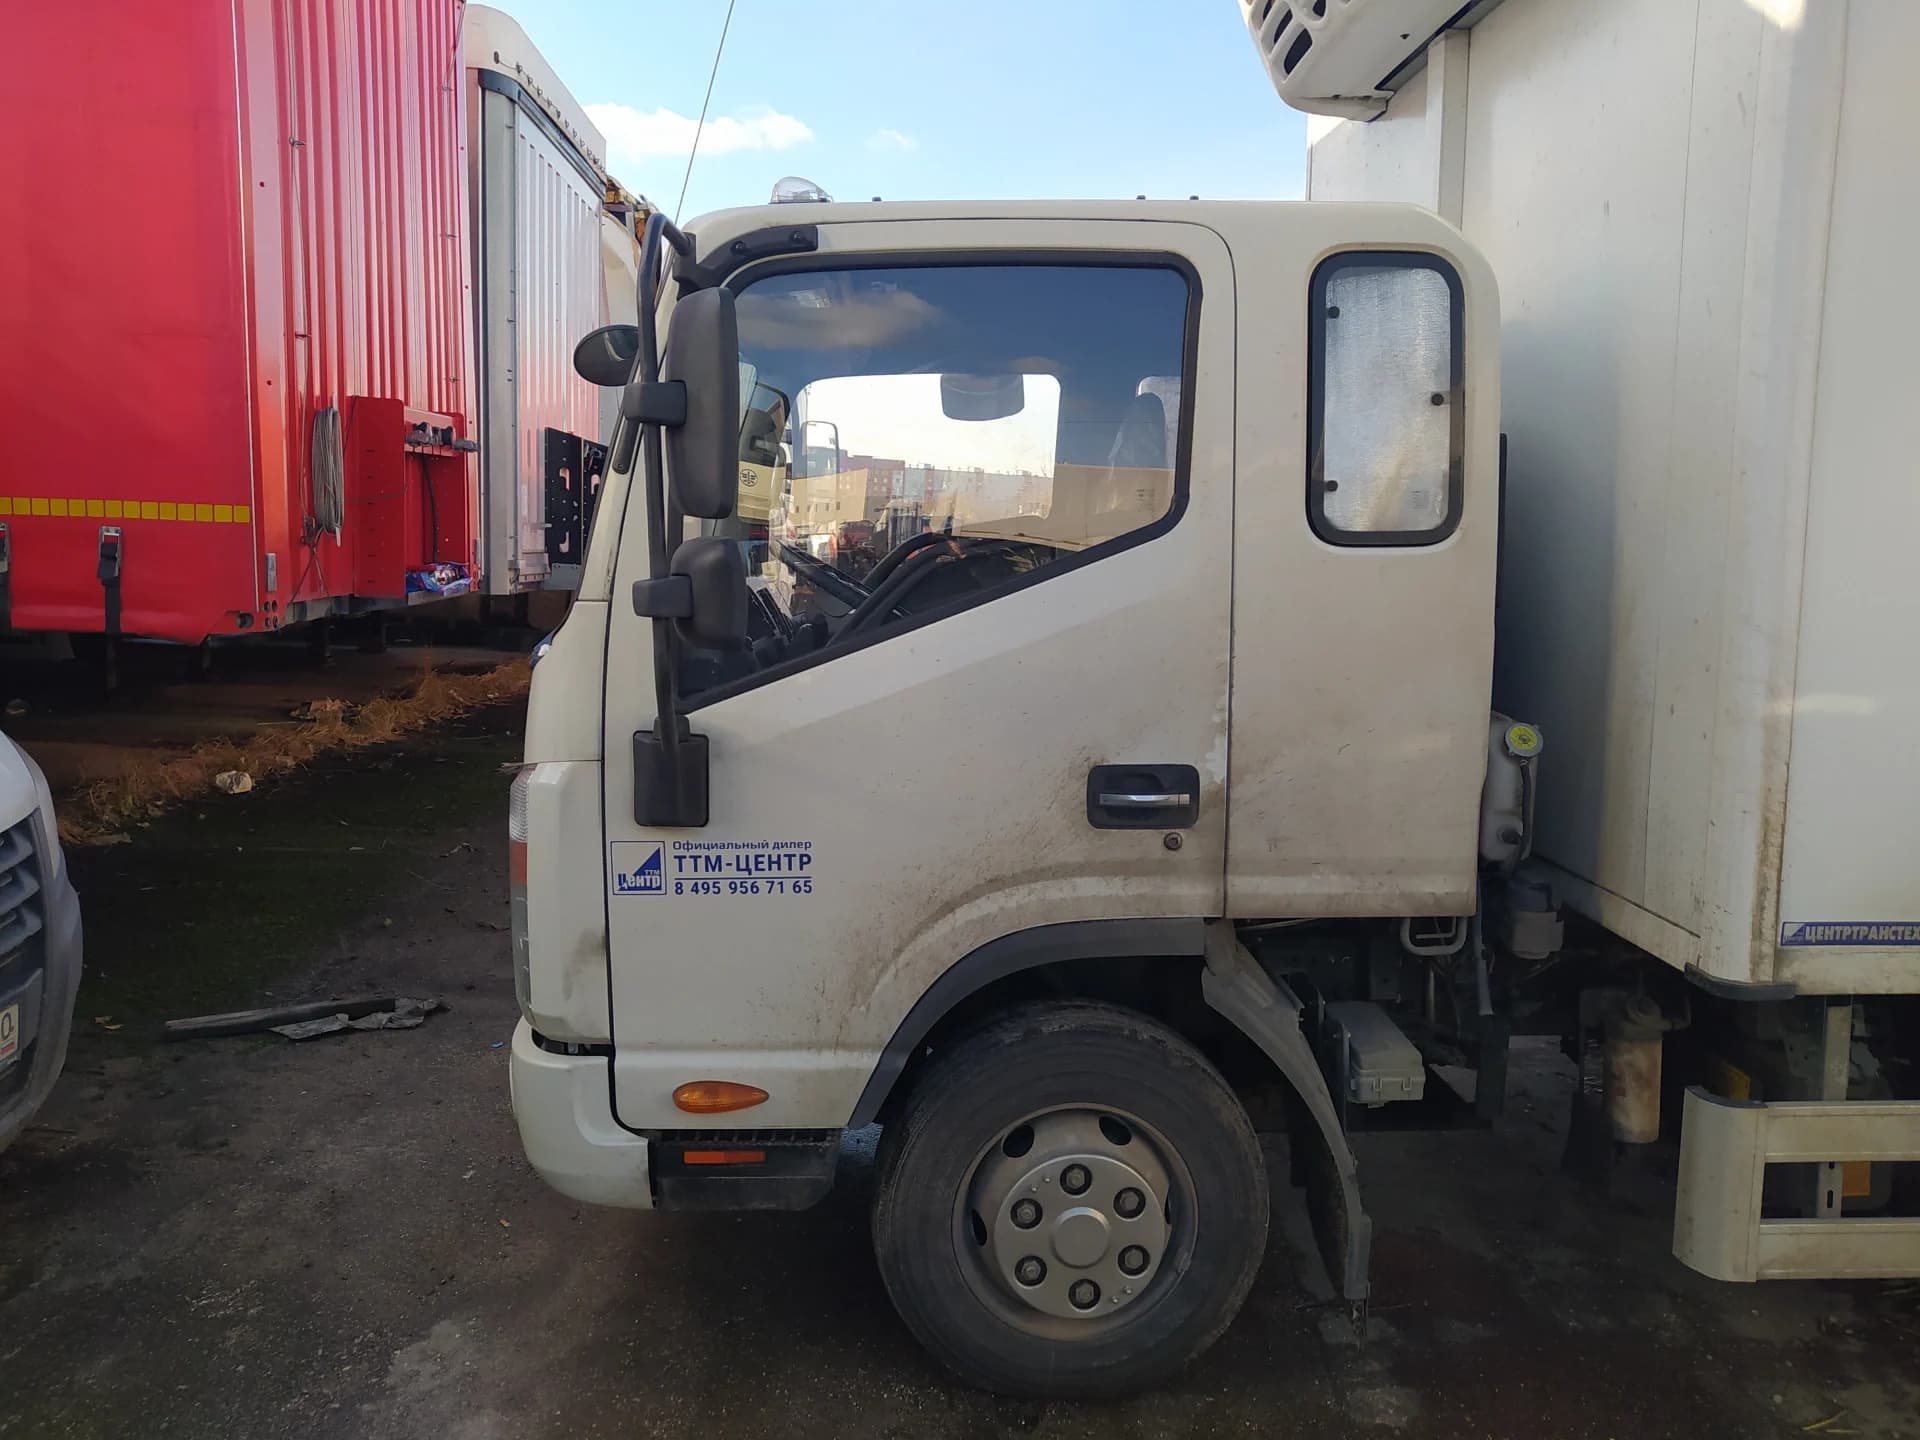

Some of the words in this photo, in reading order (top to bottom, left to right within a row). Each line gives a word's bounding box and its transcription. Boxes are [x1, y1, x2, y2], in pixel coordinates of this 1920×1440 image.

[673, 840, 769, 851] Официальный
[772, 841, 812, 850] дилер
[673, 853, 812, 875] ТТМ-ЦЕНТР
[674, 881, 684, 895] 8
[690, 881, 721, 895] 495
[728, 880, 760, 894] 956
[765, 880, 785, 894] 71
[792, 880, 812, 894] 65
